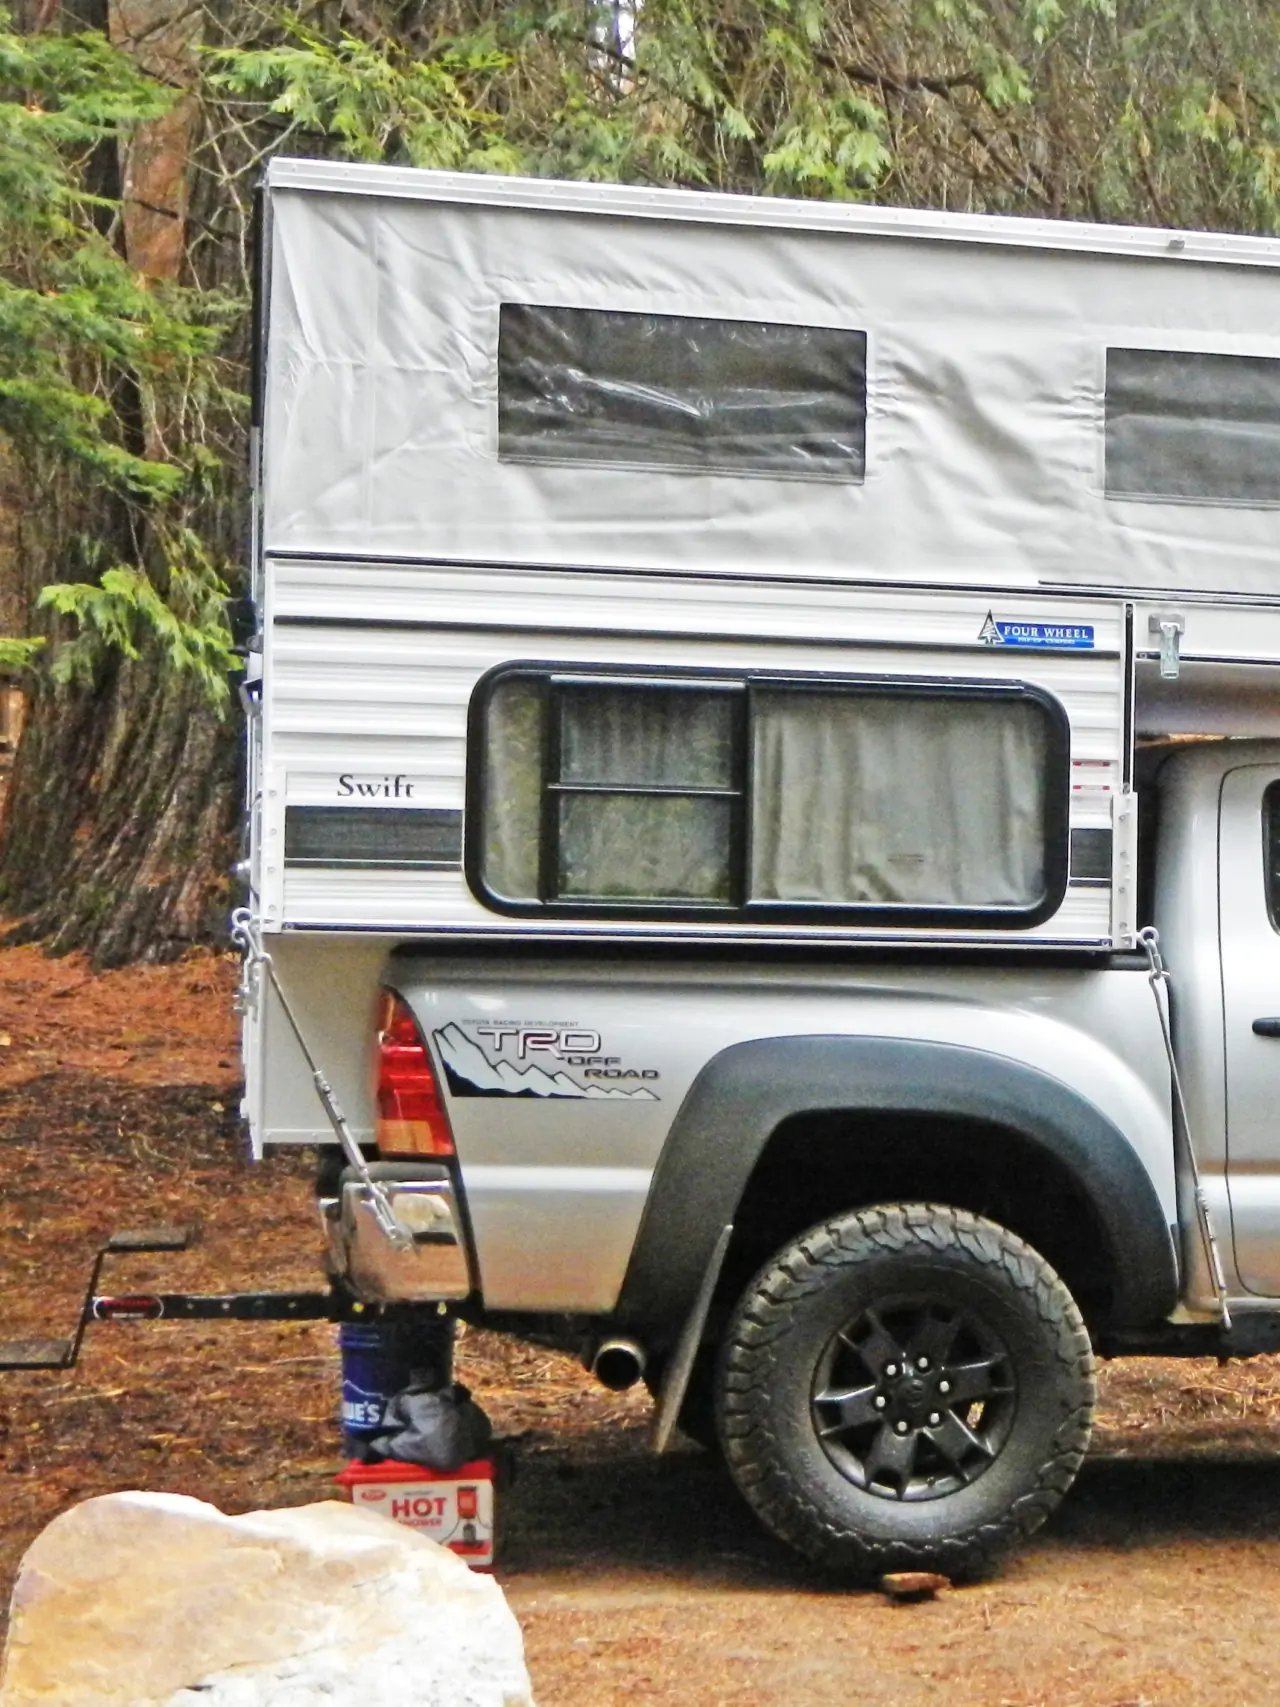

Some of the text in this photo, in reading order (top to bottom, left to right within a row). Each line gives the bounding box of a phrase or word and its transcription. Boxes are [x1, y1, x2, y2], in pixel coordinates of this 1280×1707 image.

[1004, 626, 1089, 638] FOUR WHEEL
[337, 774, 415, 798] Swift
[477, 1028, 601, 1060] TRD
[567, 1056, 622, 1066] OFF
[583, 1068, 659, 1080] ROAD
[391, 1497, 447, 1518] HOT
